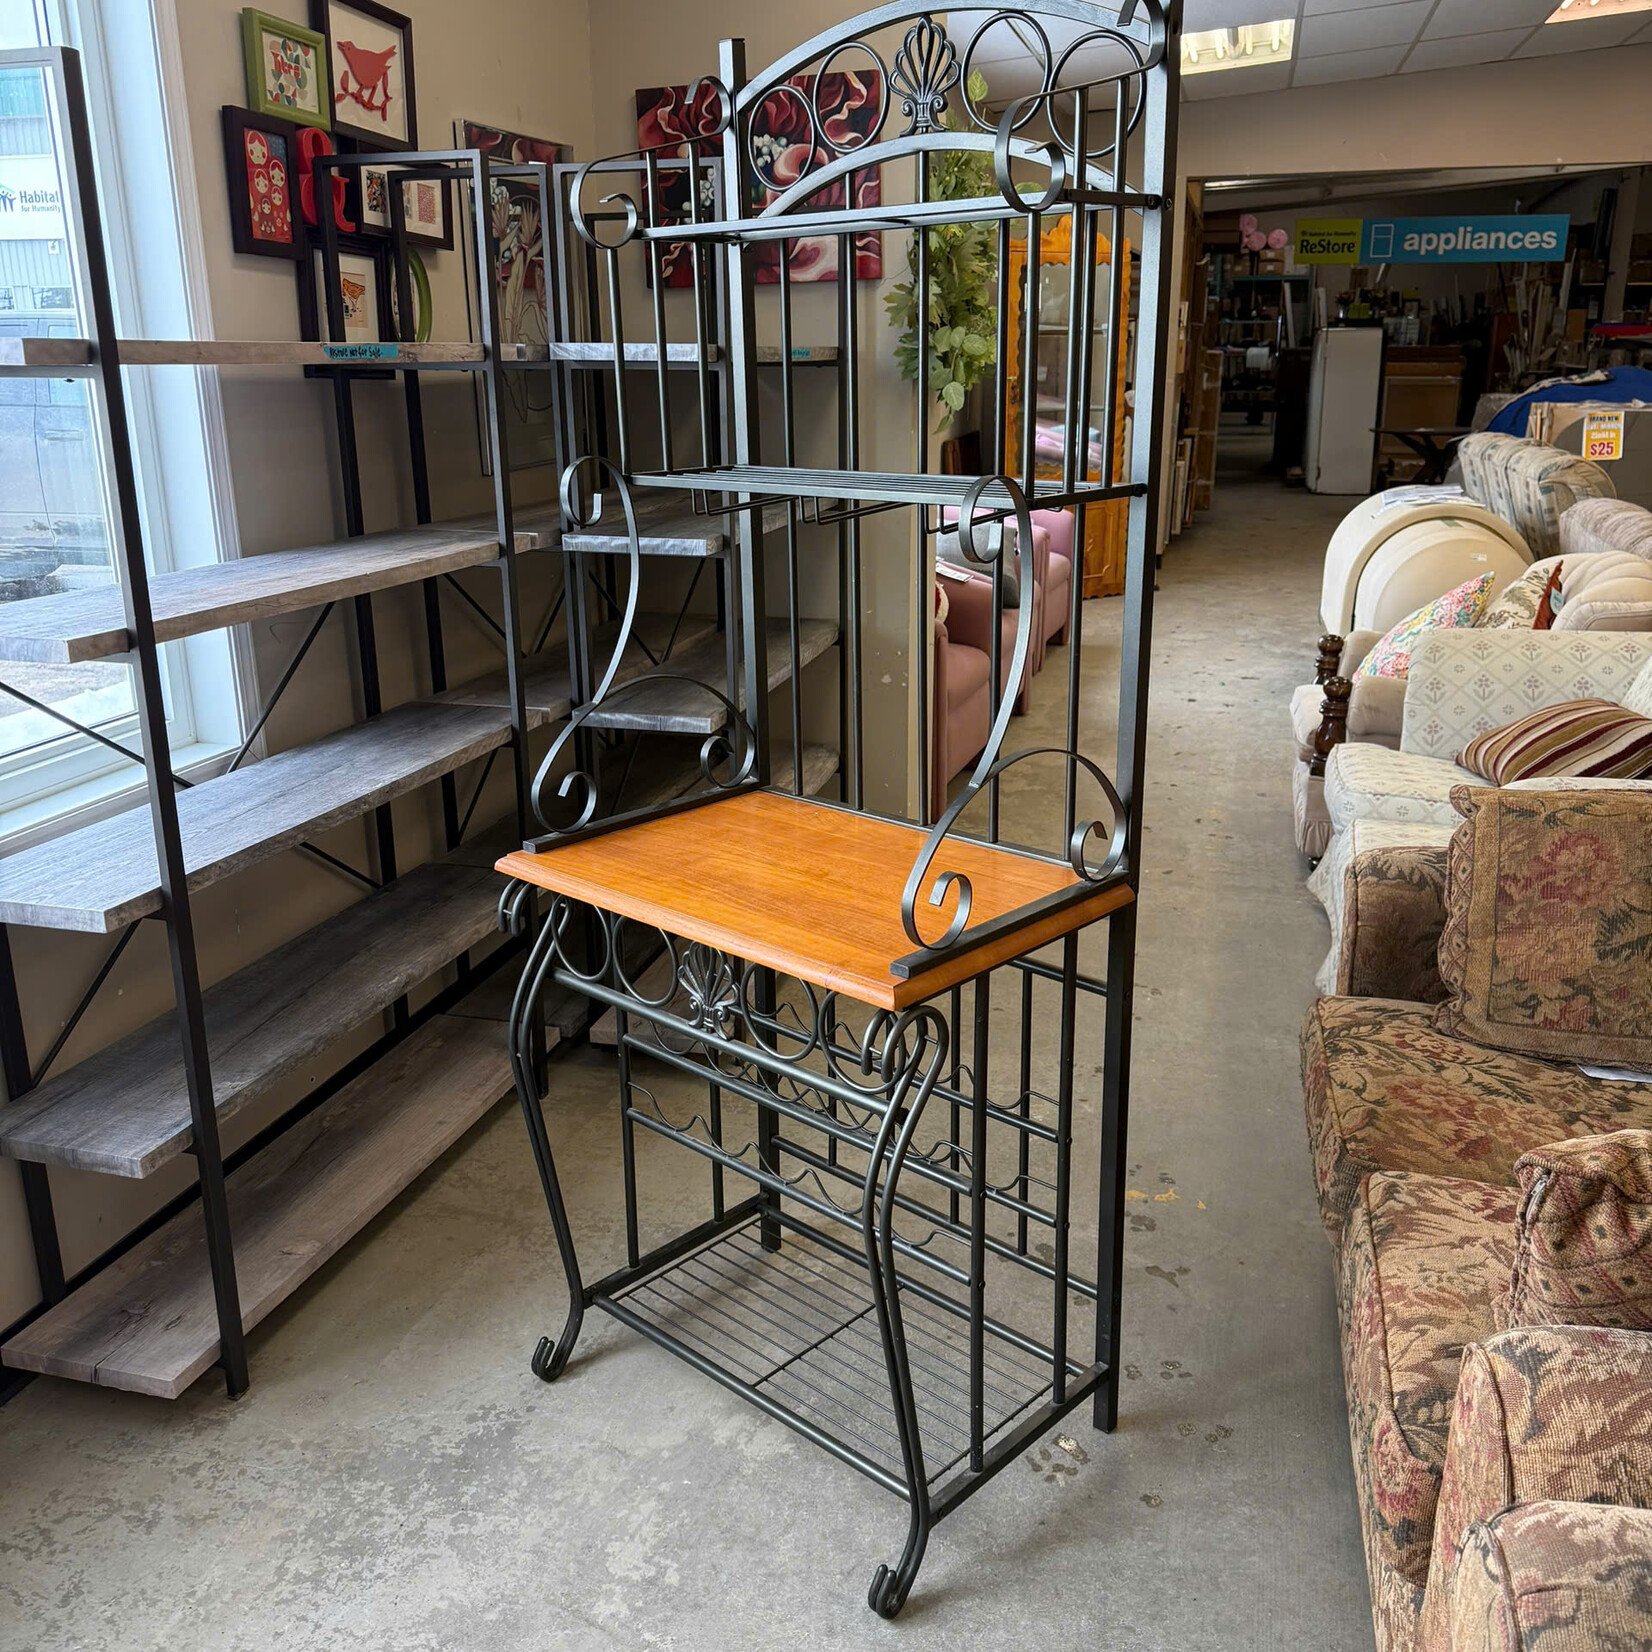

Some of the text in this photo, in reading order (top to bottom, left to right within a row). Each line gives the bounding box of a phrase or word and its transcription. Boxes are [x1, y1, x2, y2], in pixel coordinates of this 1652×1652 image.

[1300, 239, 1356, 254] ReStore
[1403, 226, 1558, 255] appliances
[1590, 442, 1614, 455] $25
